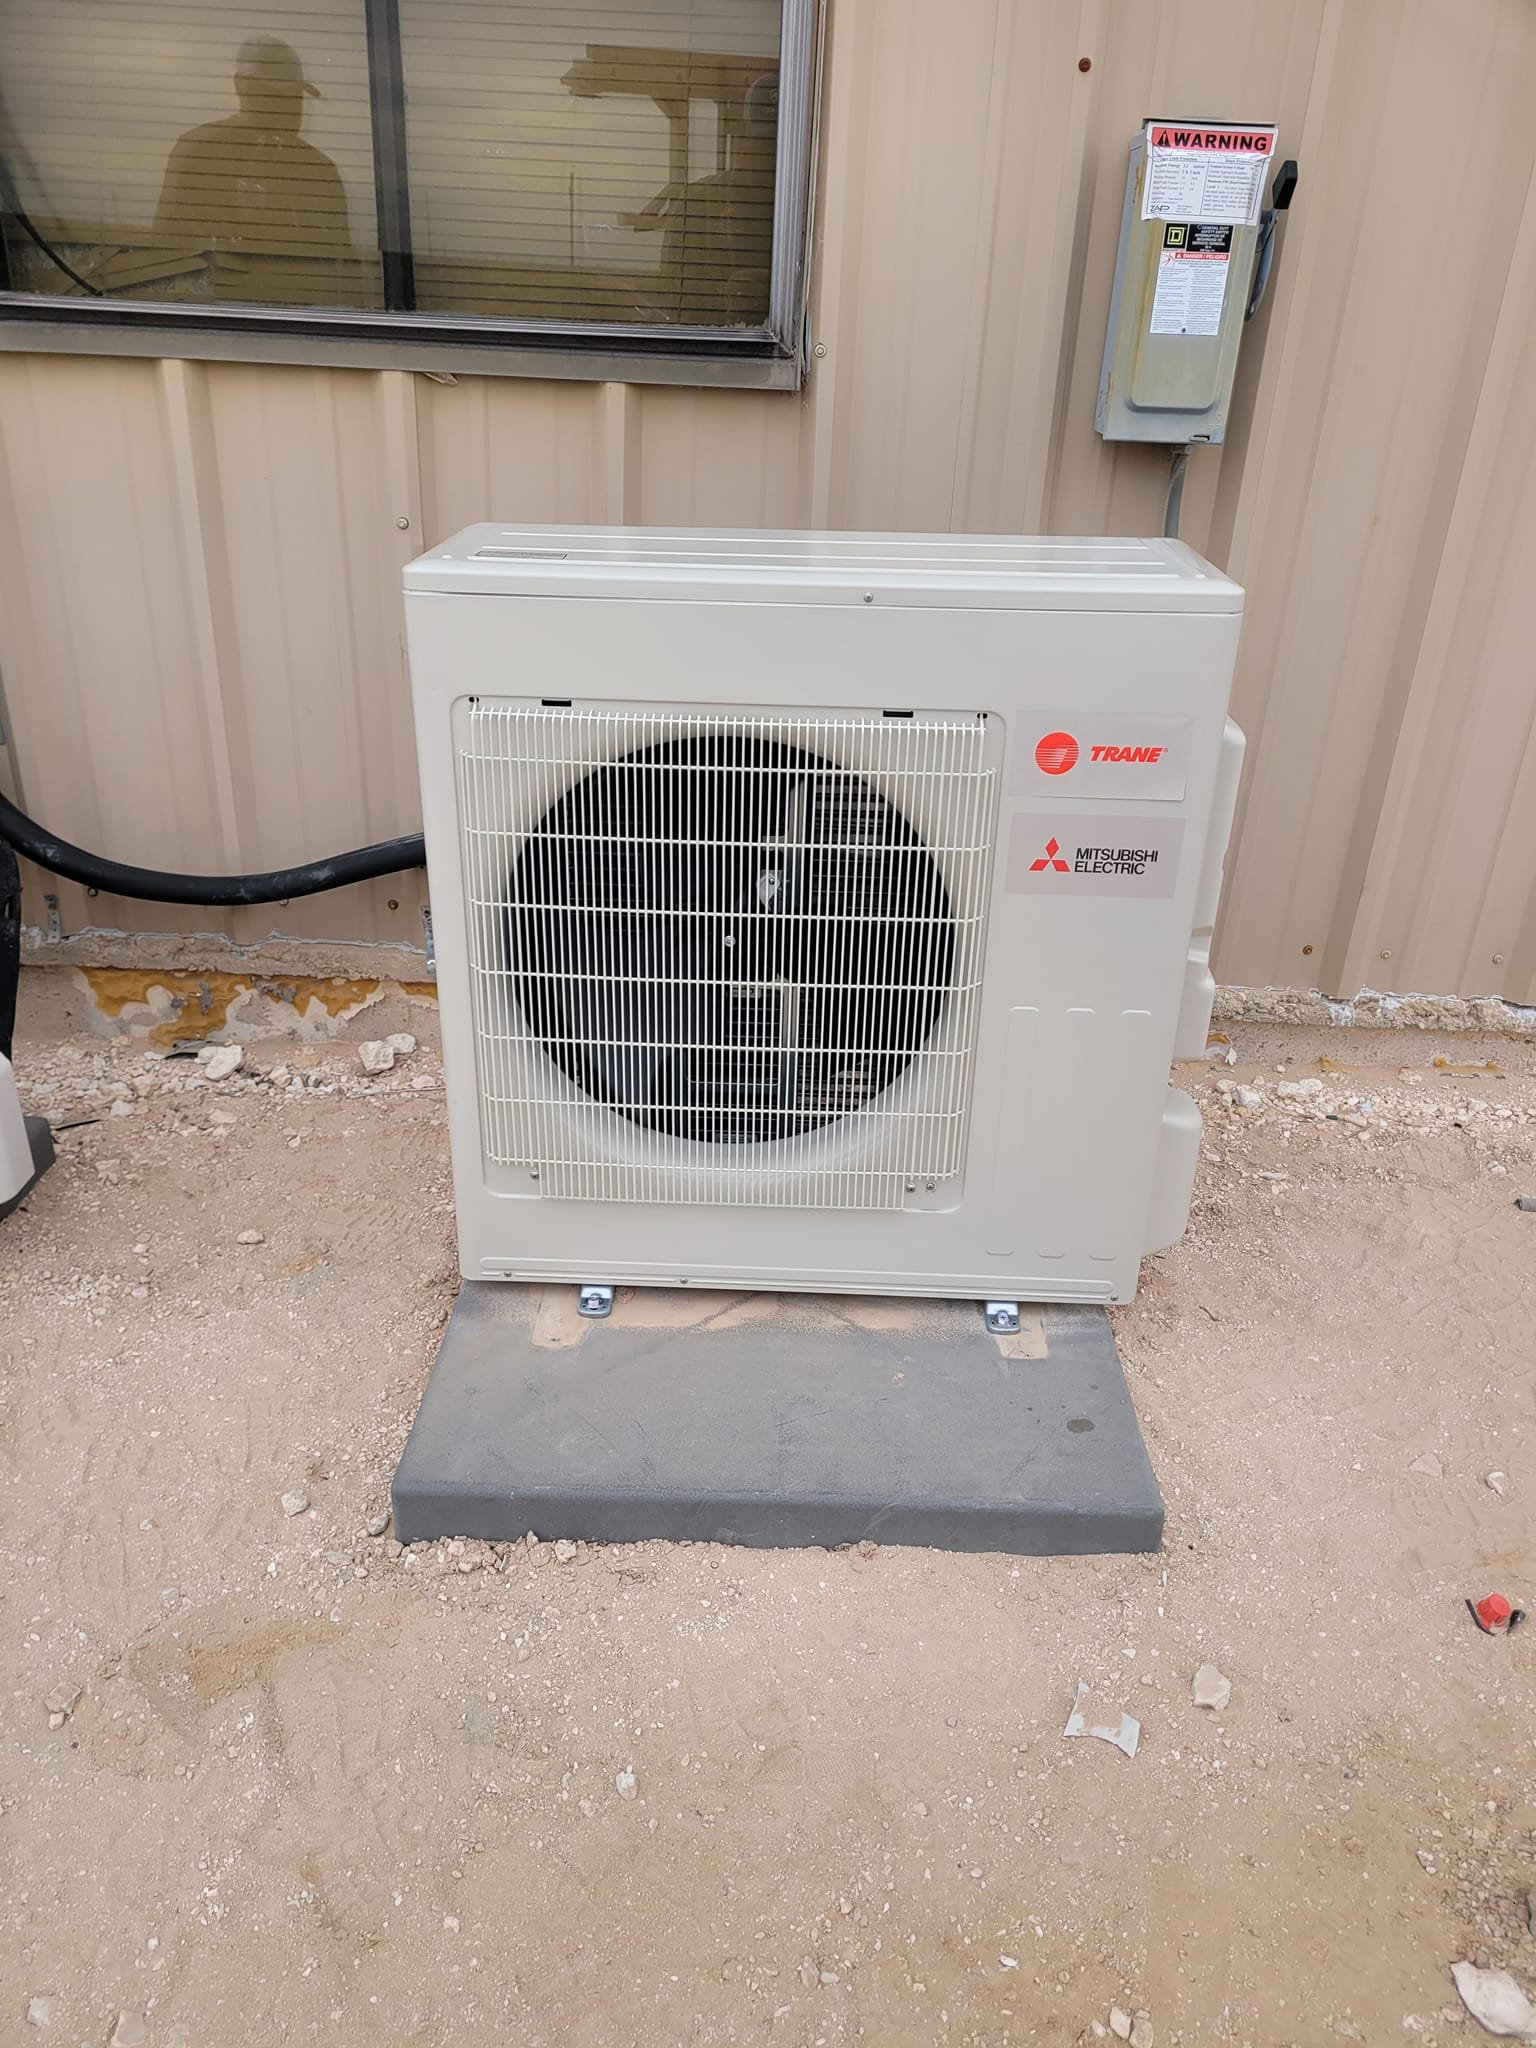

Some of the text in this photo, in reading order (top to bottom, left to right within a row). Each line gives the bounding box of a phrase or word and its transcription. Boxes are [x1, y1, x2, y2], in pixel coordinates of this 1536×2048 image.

[1174, 132, 1267, 151] WARNING
[1090, 746, 1163, 763] TRANE
[1076, 848, 1159, 863] MITSUBISHI
[1074, 861, 1146, 875] ELECTRIC
